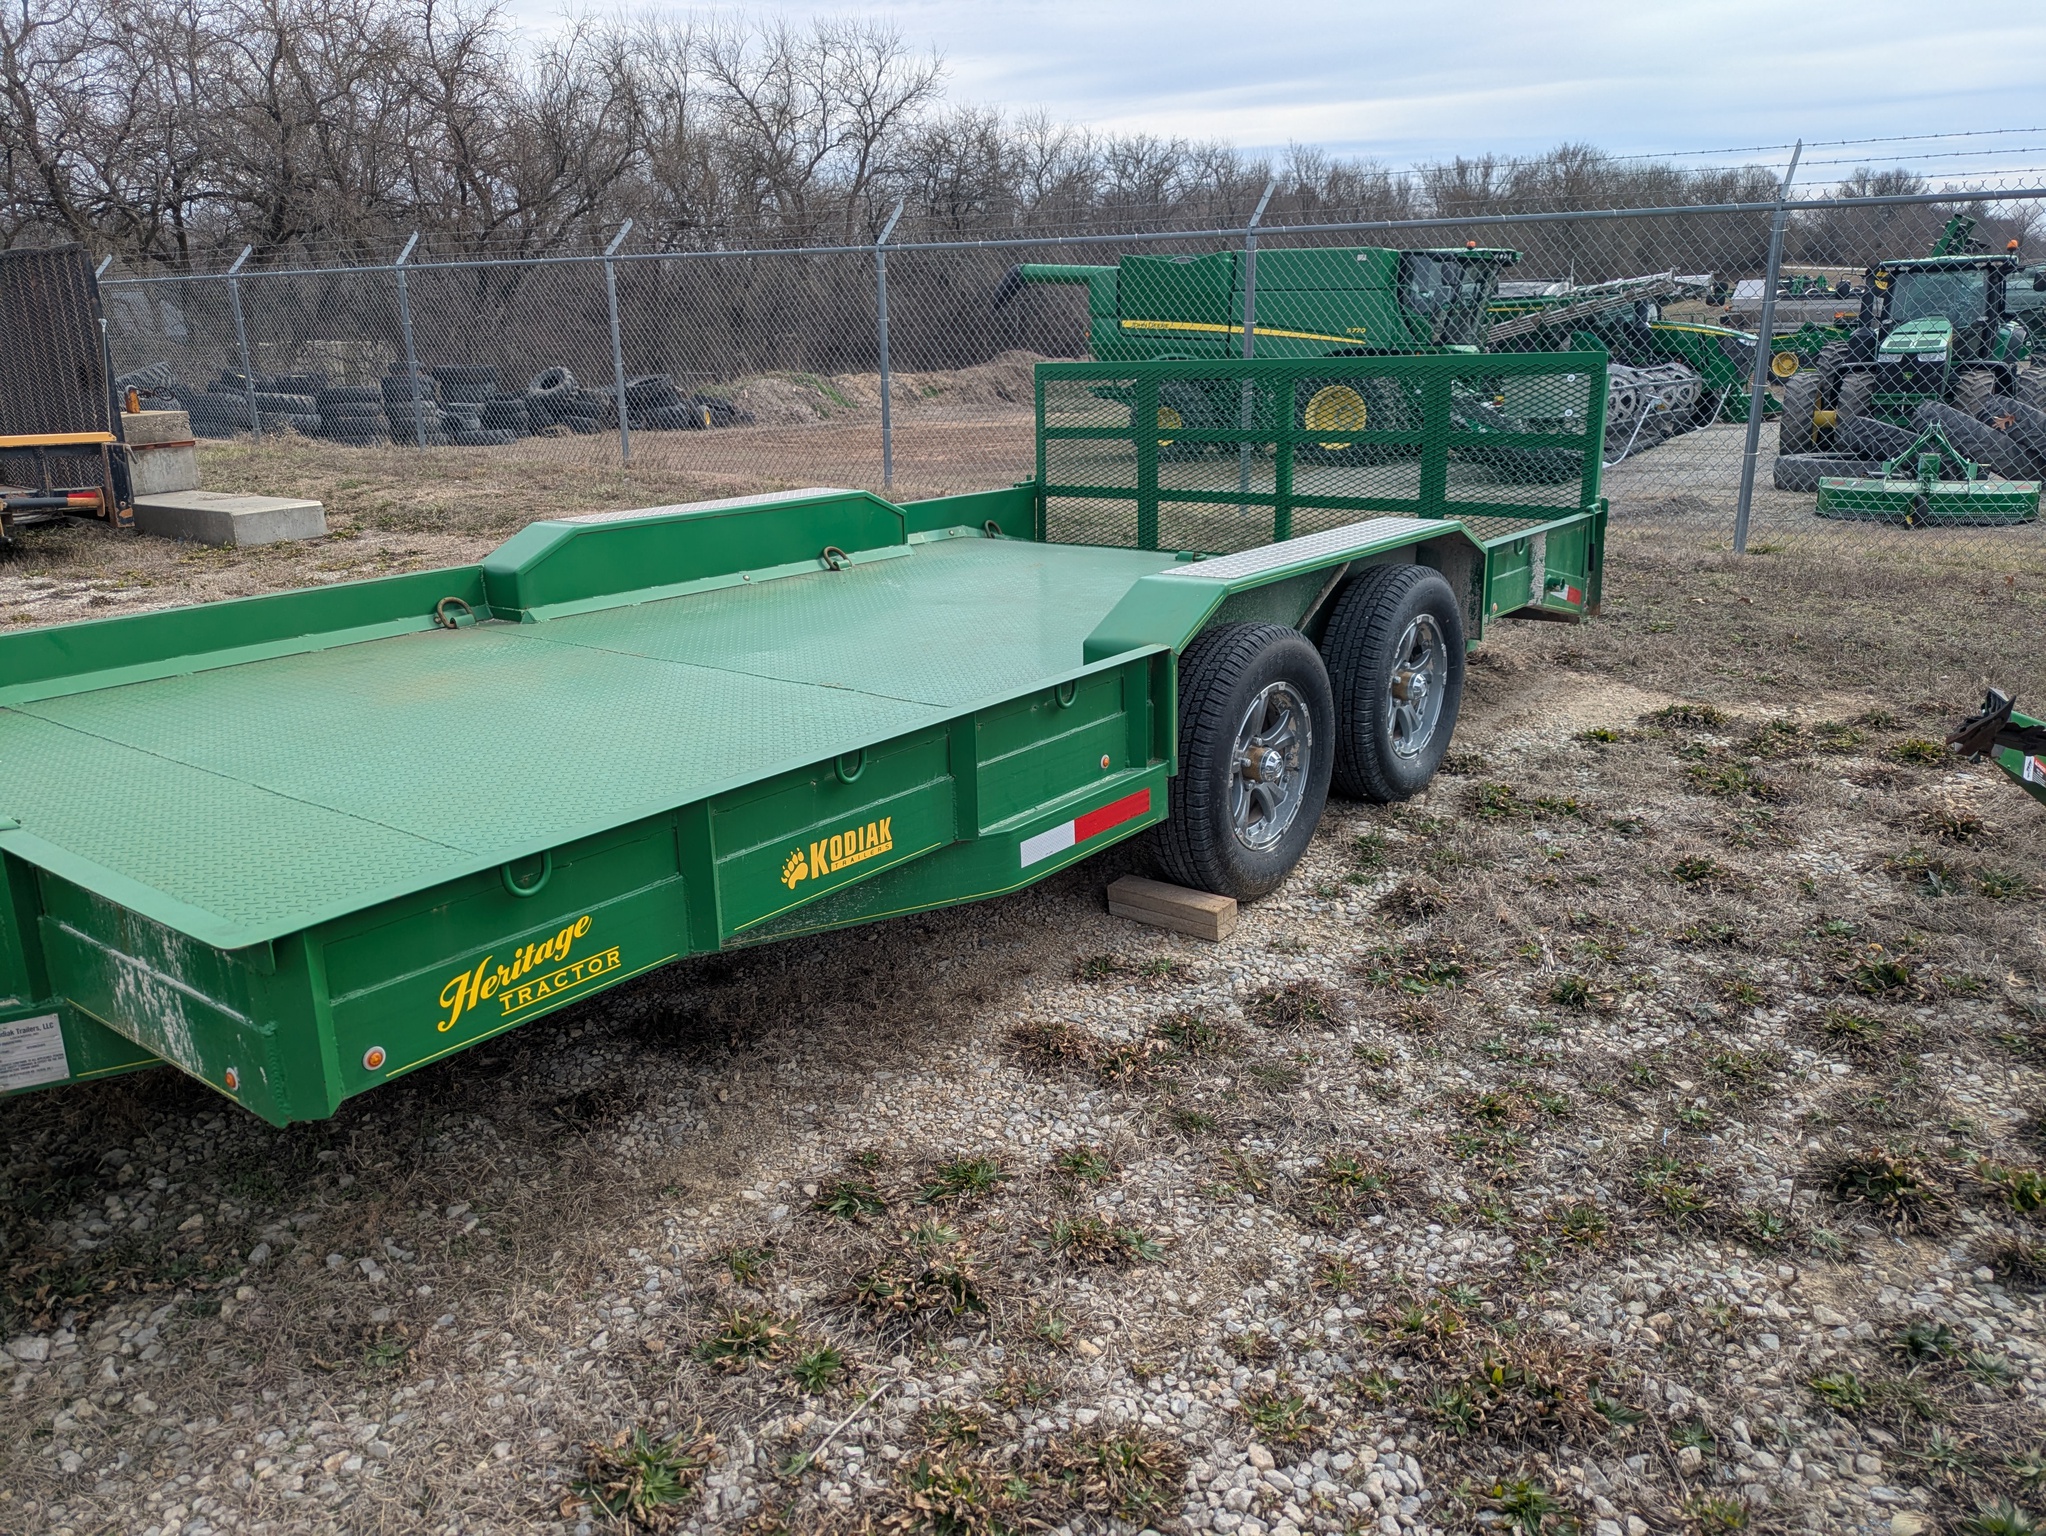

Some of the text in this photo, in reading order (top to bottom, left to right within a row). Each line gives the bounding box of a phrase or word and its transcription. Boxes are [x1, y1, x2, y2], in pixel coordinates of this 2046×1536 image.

[810, 816, 892, 880] KODIAK
[834, 844, 890, 869] TRAILERS
[437, 915, 593, 1033] Heritage
[500, 950, 621, 1010] TRACTOR
[16, 1026, 41, 1034] Trailers,
